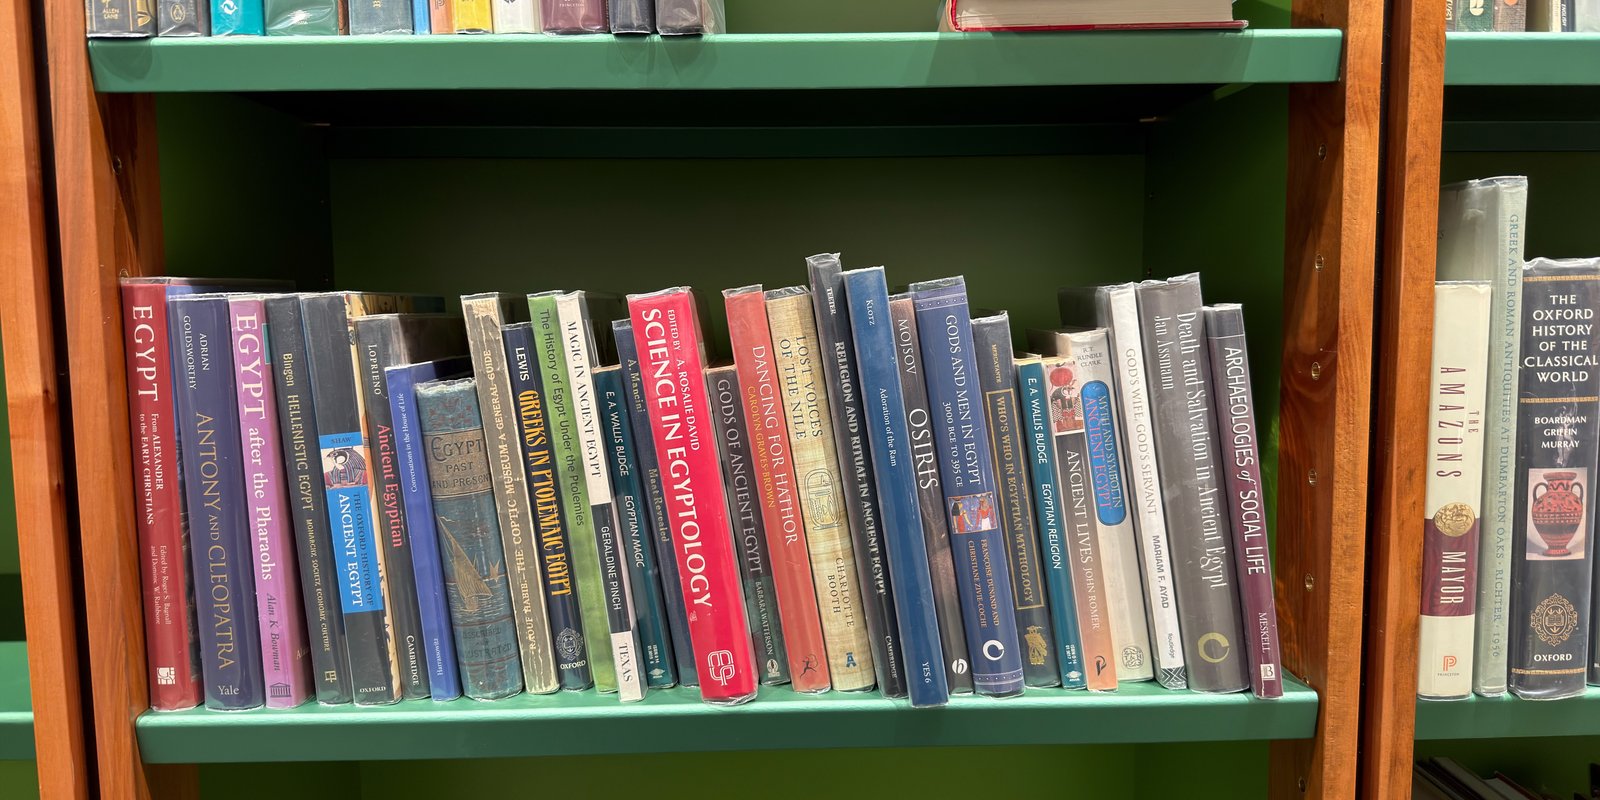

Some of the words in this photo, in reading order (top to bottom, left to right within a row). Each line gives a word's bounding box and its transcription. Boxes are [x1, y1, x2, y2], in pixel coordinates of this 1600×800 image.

[1509, 215, 1519, 253] GREEK
[1508, 258, 1517, 287] AND
[1505, 291, 1516, 336] ROMAN
[1533, 309, 1593, 321] OXFORD
[1549, 295, 1576, 305] THE
[539, 309, 549, 330] The
[667, 310, 678, 339] EDITED
[945, 314, 962, 354] GODS
[1154, 316, 1172, 336] Jan
[1176, 312, 1200, 354] Death
[1532, 324, 1593, 336] HISTORY
[132, 306, 158, 401] EGYPT
[183, 316, 197, 390] GOLDSWORTHY
[199, 333, 210, 371] ADRIAN
[543, 333, 557, 370] History
[566, 321, 582, 360] MAGIC
[642, 308, 678, 409] SCIENCE
[673, 340, 681, 351] BY
[780, 339, 792, 358] OF
[898, 319, 916, 374] MOJSOV
[1539, 342, 1556, 352] OF
[1562, 341, 1587, 350] THE
[235, 313, 266, 420] EGYPT
[283, 353, 294, 387] Bingen
[368, 344, 381, 395] LOPRIENO
[515, 347, 530, 381] LEWIS
[552, 373, 562, 384] of
[574, 365, 584, 377] IN
[676, 359, 685, 370] A.
[785, 364, 799, 396] THE
[952, 357, 966, 387] AND
[1126, 348, 1140, 385] GOD'S
[1156, 340, 1174, 390] Assmann
[1182, 359, 1204, 385] and
[1524, 354, 1598, 368] CLASSICAL
[1537, 371, 1589, 383] WORLD
[679, 371, 692, 415] ROSALIE
[796, 337, 812, 375] LOST
[805, 382, 822, 437] VOICES
[835, 342, 854, 402] RELIGION
[845, 406, 858, 432] AND
[1502, 341, 1514, 424] ANTIQUITIES
[519, 390, 547, 447] GREEKS
[552, 387, 564, 418] Egypt
[576, 381, 595, 436] ANCIENT
[717, 379, 736, 425] GODS
[748, 387, 762, 430] CAROLYN
[791, 402, 806, 439] NILE
[880, 388, 890, 425] Adoration
[886, 426, 894, 434] of
[942, 402, 953, 424] 3000
[957, 390, 971, 420] MEN
[997, 396, 1009, 432] WHO'S
[1031, 399, 1043, 431] WALLIS
[1132, 388, 1144, 422] WIFE,
[1224, 347, 1253, 467] ARCHAEOLOGIES
[1534, 416, 1586, 424] BOARDMAN
[287, 395, 307, 470] HELLENISTIC
[559, 422, 570, 451] Under
[660, 413, 683, 442] IN
[684, 414, 700, 450] DAVID
[726, 430, 741, 448] OF
[947, 426, 956, 443] BCE
[962, 424, 974, 439] IN
[1085, 397, 1105, 459] ANCIENT
[1187, 389, 1210, 461] Salvation
[1436, 367, 1466, 478] AMAZONS
[1468, 411, 1479, 433] THE
[1500, 427, 1510, 444] AT
[141, 437, 150, 466] EARLY
[196, 412, 222, 511] ANTONY
[249, 427, 265, 466] after
[377, 424, 396, 480] Ancient
[432, 437, 482, 461] EGYPT
[528, 450, 550, 466] IN
[586, 439, 602, 478] EGYPT
[609, 411, 623, 444] WALLIS
[616, 446, 629, 477] BUDGE
[752, 346, 779, 429] DANCING
[768, 436, 784, 468] FOR
[776, 473, 798, 544] HATHOR
[909, 408, 938, 489] OSIRIS
[950, 444, 957, 458] TO
[1002, 435, 1012, 461] WHO
[1035, 433, 1047, 464] BUDGE
[1136, 424, 1150, 461] GOD'S
[1541, 440, 1579, 448] MURRAY
[152, 434, 164, 491] ALEXANDER
[446, 462, 473, 473] PAST
[565, 454, 574, 472] the
[951, 459, 961, 474] 395
[964, 442, 981, 485] EGYPT
[1006, 463, 1015, 475] IN
[1196, 465, 1214, 480] in
[1236, 472, 1256, 484] of
[144, 468, 154, 524] CHRISTIANS
[251, 468, 268, 498] the
[567, 474, 584, 526] Ptolemies
[730, 452, 753, 520] ANCIENT
[956, 477, 963, 488] CE
[1066, 450, 1087, 518] ANCIENT
[1141, 464, 1157, 514] SERVANT
[1497, 447, 1509, 523] DUMBARTON
[385, 482, 403, 548] Egyptian
[507, 499, 522, 545] COPTIC
[530, 470, 563, 550] PTOLEMAIC
[1042, 483, 1055, 526] EGYPTIAN
[1198, 488, 1220, 544] Ancient
[1240, 490, 1261, 542] SOCIAL
[208, 515, 220, 541] AND
[256, 506, 276, 580] Pharaohs
[357, 512, 366, 550] OXFORD
[624, 495, 639, 537] EGYPTIAN
[632, 539, 645, 568] MAGIC
[668, 446, 712, 607] EGYPTOLOGY
[1076, 522, 1093, 565] LIVES
[1496, 527, 1505, 559] OAKS
[338, 494, 358, 557] ANCIENT
[348, 559, 363, 607] EGYPT
[742, 525, 763, 574] EGYPT
[1047, 528, 1061, 569] RELIGION
[1152, 535, 1164, 573] MARIAM
[1200, 546, 1227, 589] Egypt
[1246, 546, 1266, 575] LIFE
[545, 553, 572, 596] EGYPT
[601, 526, 617, 578] GERALDINE
[610, 582, 622, 610] PINCH
[1083, 567, 1096, 592] JOHN
[1158, 574, 1166, 583] F.
[1440, 551, 1466, 605] MAYOR
[208, 545, 235, 670] CLEOPATRA
[267, 594, 276, 617] Alan
[828, 575, 841, 614] BOOTH
[835, 557, 855, 627] CHARLOTTE
[1159, 586, 1169, 609] AYAD
[1494, 569, 1504, 622] RICHTER
[1086, 594, 1100, 630] ROMER
[270, 632, 281, 671] Bowman
[1259, 612, 1270, 654] MESKELL
[406, 635, 419, 686] CAMBRIDGE
[560, 660, 586, 670] OXFORD
[618, 643, 633, 683] TEXAS
[922, 661, 931, 677] YES
[1534, 654, 1572, 662] OXFORD
[218, 686, 240, 695] Yale
